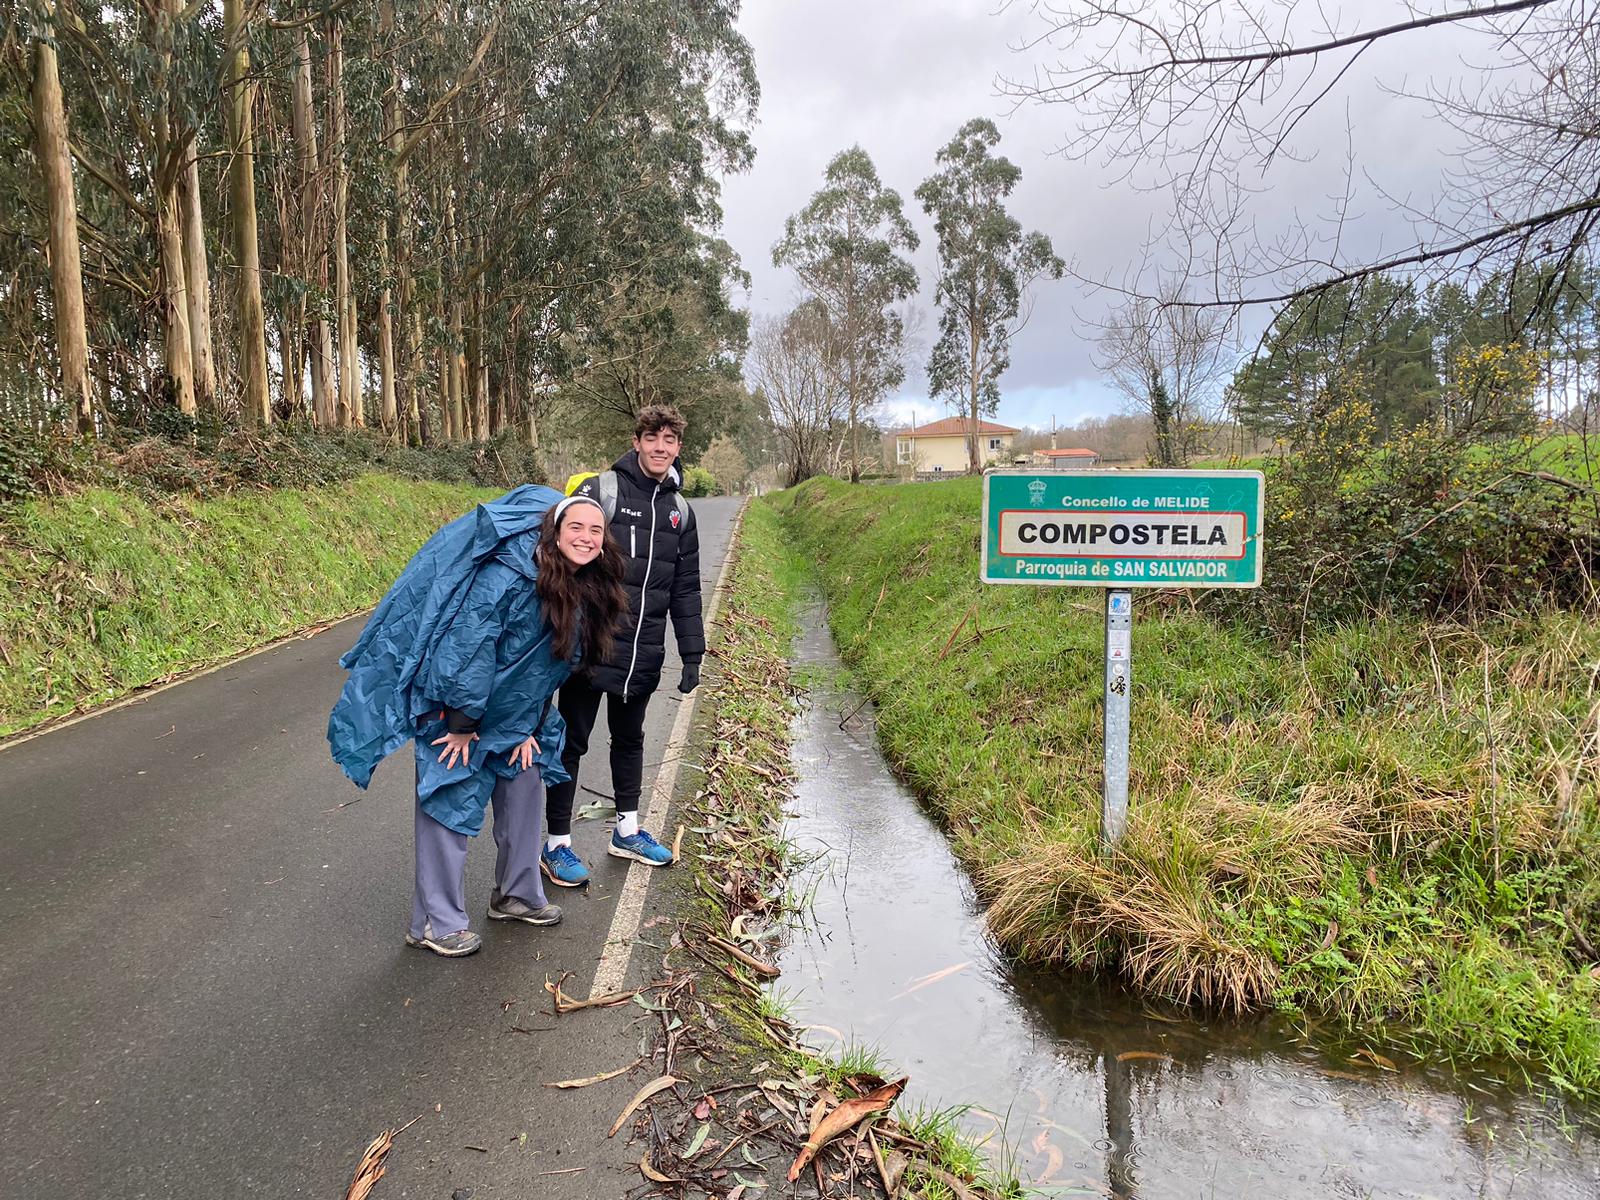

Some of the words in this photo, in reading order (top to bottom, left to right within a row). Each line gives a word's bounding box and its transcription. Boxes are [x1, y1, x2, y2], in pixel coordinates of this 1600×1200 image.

[1062, 496, 1127, 507] Concello
[1131, 496, 1150, 507] de
[1154, 496, 1210, 508] MELIDE
[1018, 522, 1227, 546] COMPOSTELA
[1016, 560, 1087, 578] Parroquia
[1091, 561, 1109, 576] de
[1114, 561, 1144, 577] SAN
[1148, 561, 1227, 577] SALVADOR
